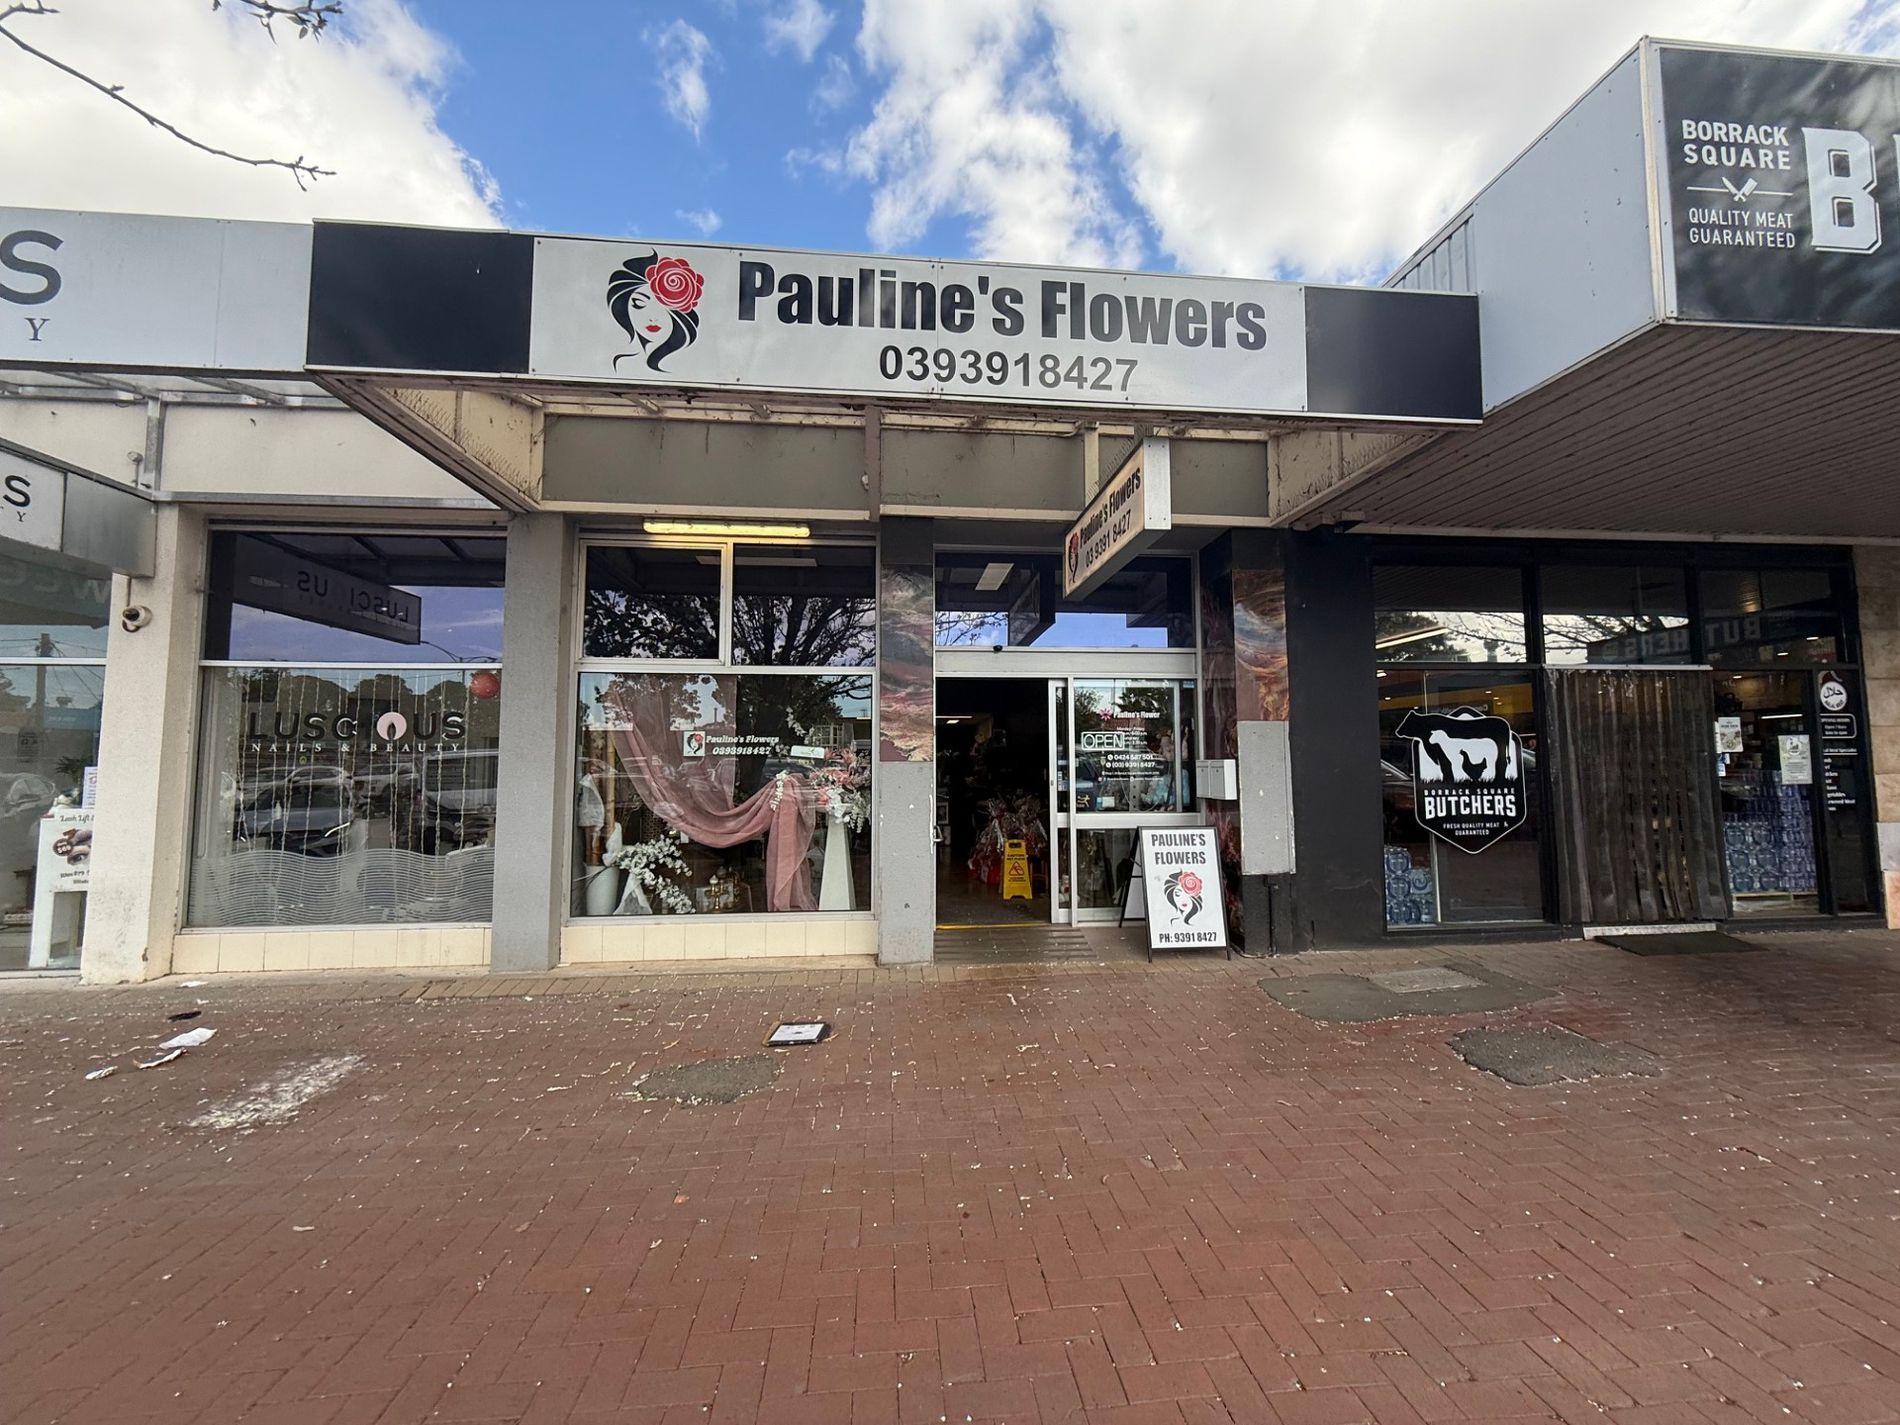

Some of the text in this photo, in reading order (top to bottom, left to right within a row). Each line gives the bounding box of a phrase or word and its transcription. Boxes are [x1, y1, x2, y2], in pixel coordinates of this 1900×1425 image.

[1681, 119, 1790, 146] BORRACK
[1683, 143, 1791, 170] SQUARE
[1801, 127, 1900, 255] B
[1688, 207, 1793, 229] QUALITY MEAT
[1689, 227, 1796, 248] GUARANTEED
[738, 260, 1267, 351] Pauline's Flowers
[880, 345, 1138, 392] 0393918427
[1080, 467, 1141, 549] Pauline's Flowers
[1086, 509, 1131, 569] 03 9391 8427
[249, 711, 466, 741] LUSCOUS
[251, 743, 460, 752] NAILS & BEAUTY
[705, 735, 780, 744] Pauline's Flowers
[712, 746, 772, 755] 0393918427
[1083, 734, 1122, 748] OPEN
[1424, 788, 1470, 796] BORRACK
[1424, 794, 1516, 820] BUTCHERS
[1151, 833, 1206, 847] PAULINE'S
[1155, 851, 1206, 865] FLOWERS
[1159, 931, 1217, 943] PH: 9391 8427
